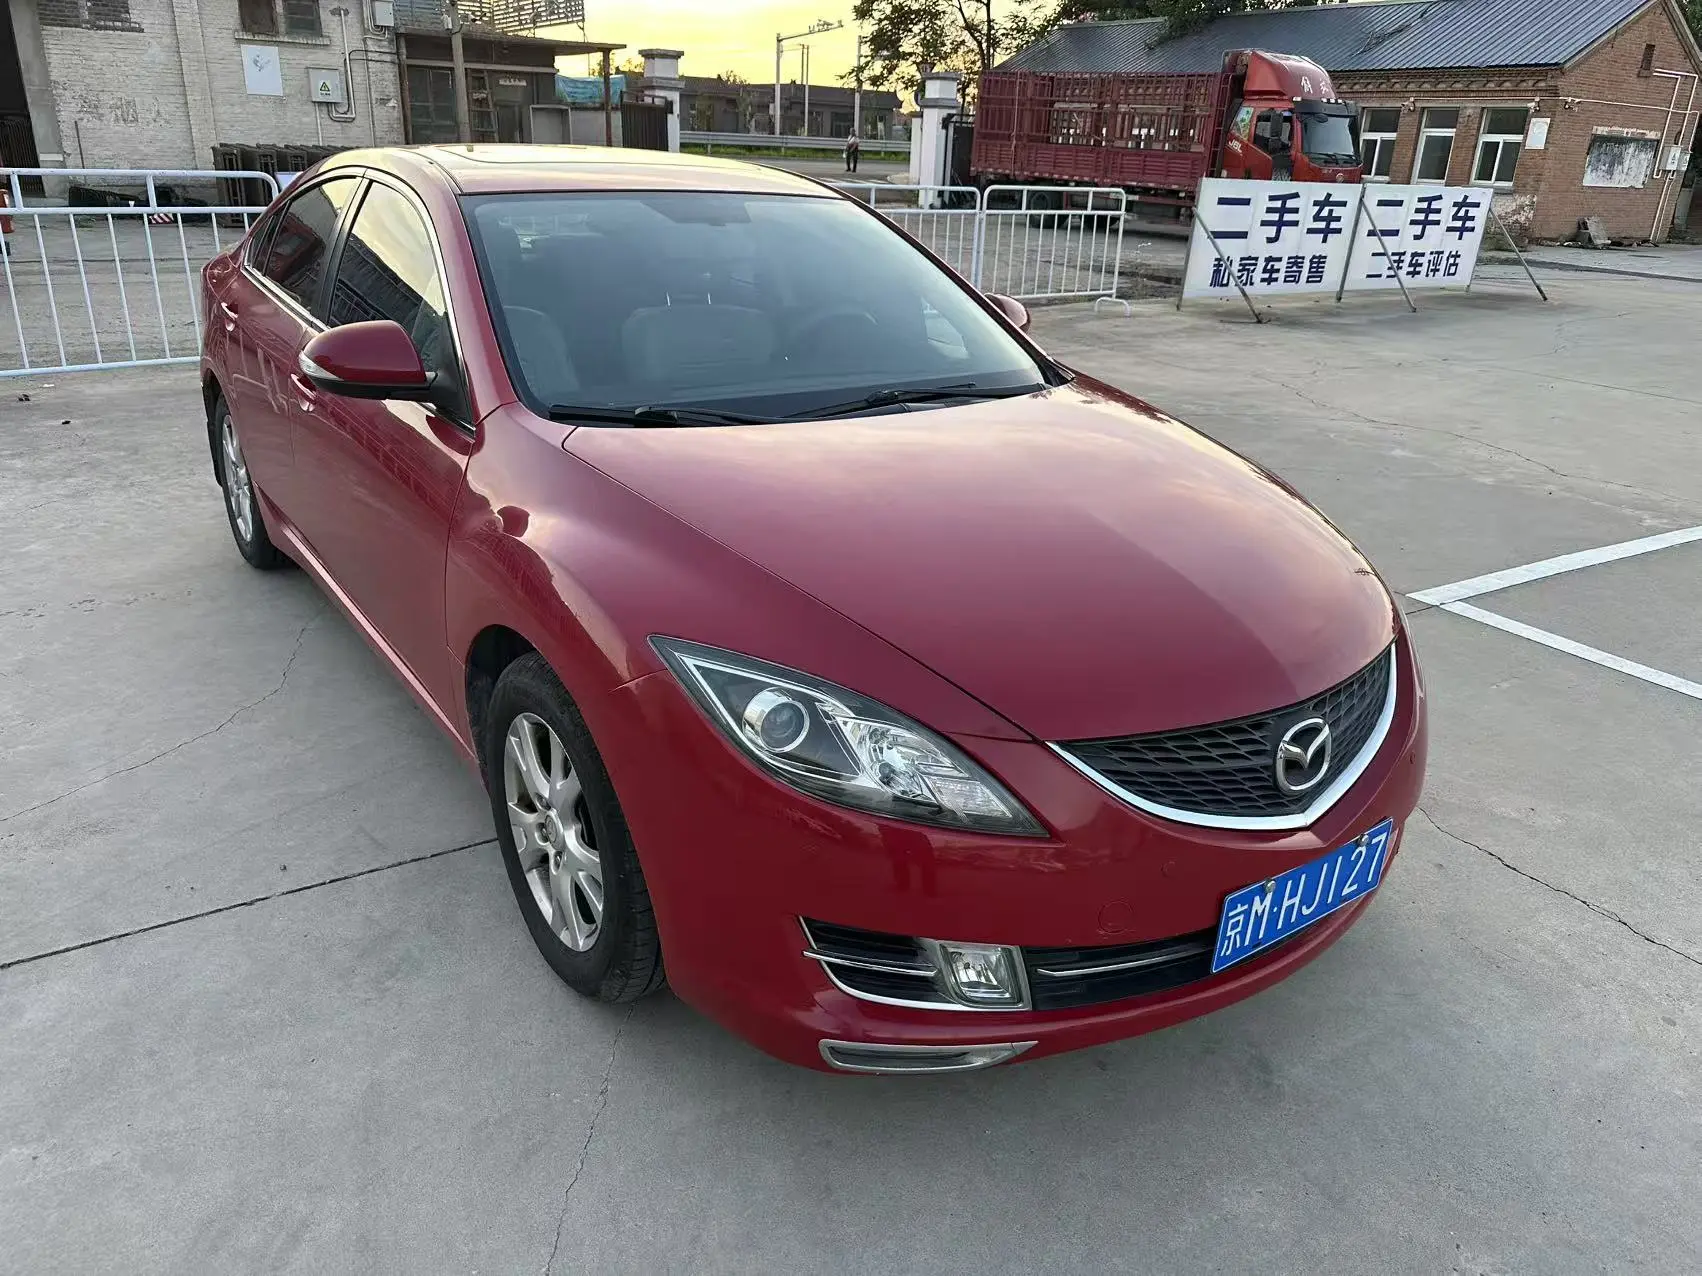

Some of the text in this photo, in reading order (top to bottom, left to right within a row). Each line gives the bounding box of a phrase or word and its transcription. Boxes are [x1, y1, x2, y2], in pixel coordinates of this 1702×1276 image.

[1208, 192, 1347, 244] 二手车
[1367, 194, 1481, 241] 二手车
[1210, 254, 1328, 288] 私家车寄售
[1366, 250, 1461, 278] 二手车评估
